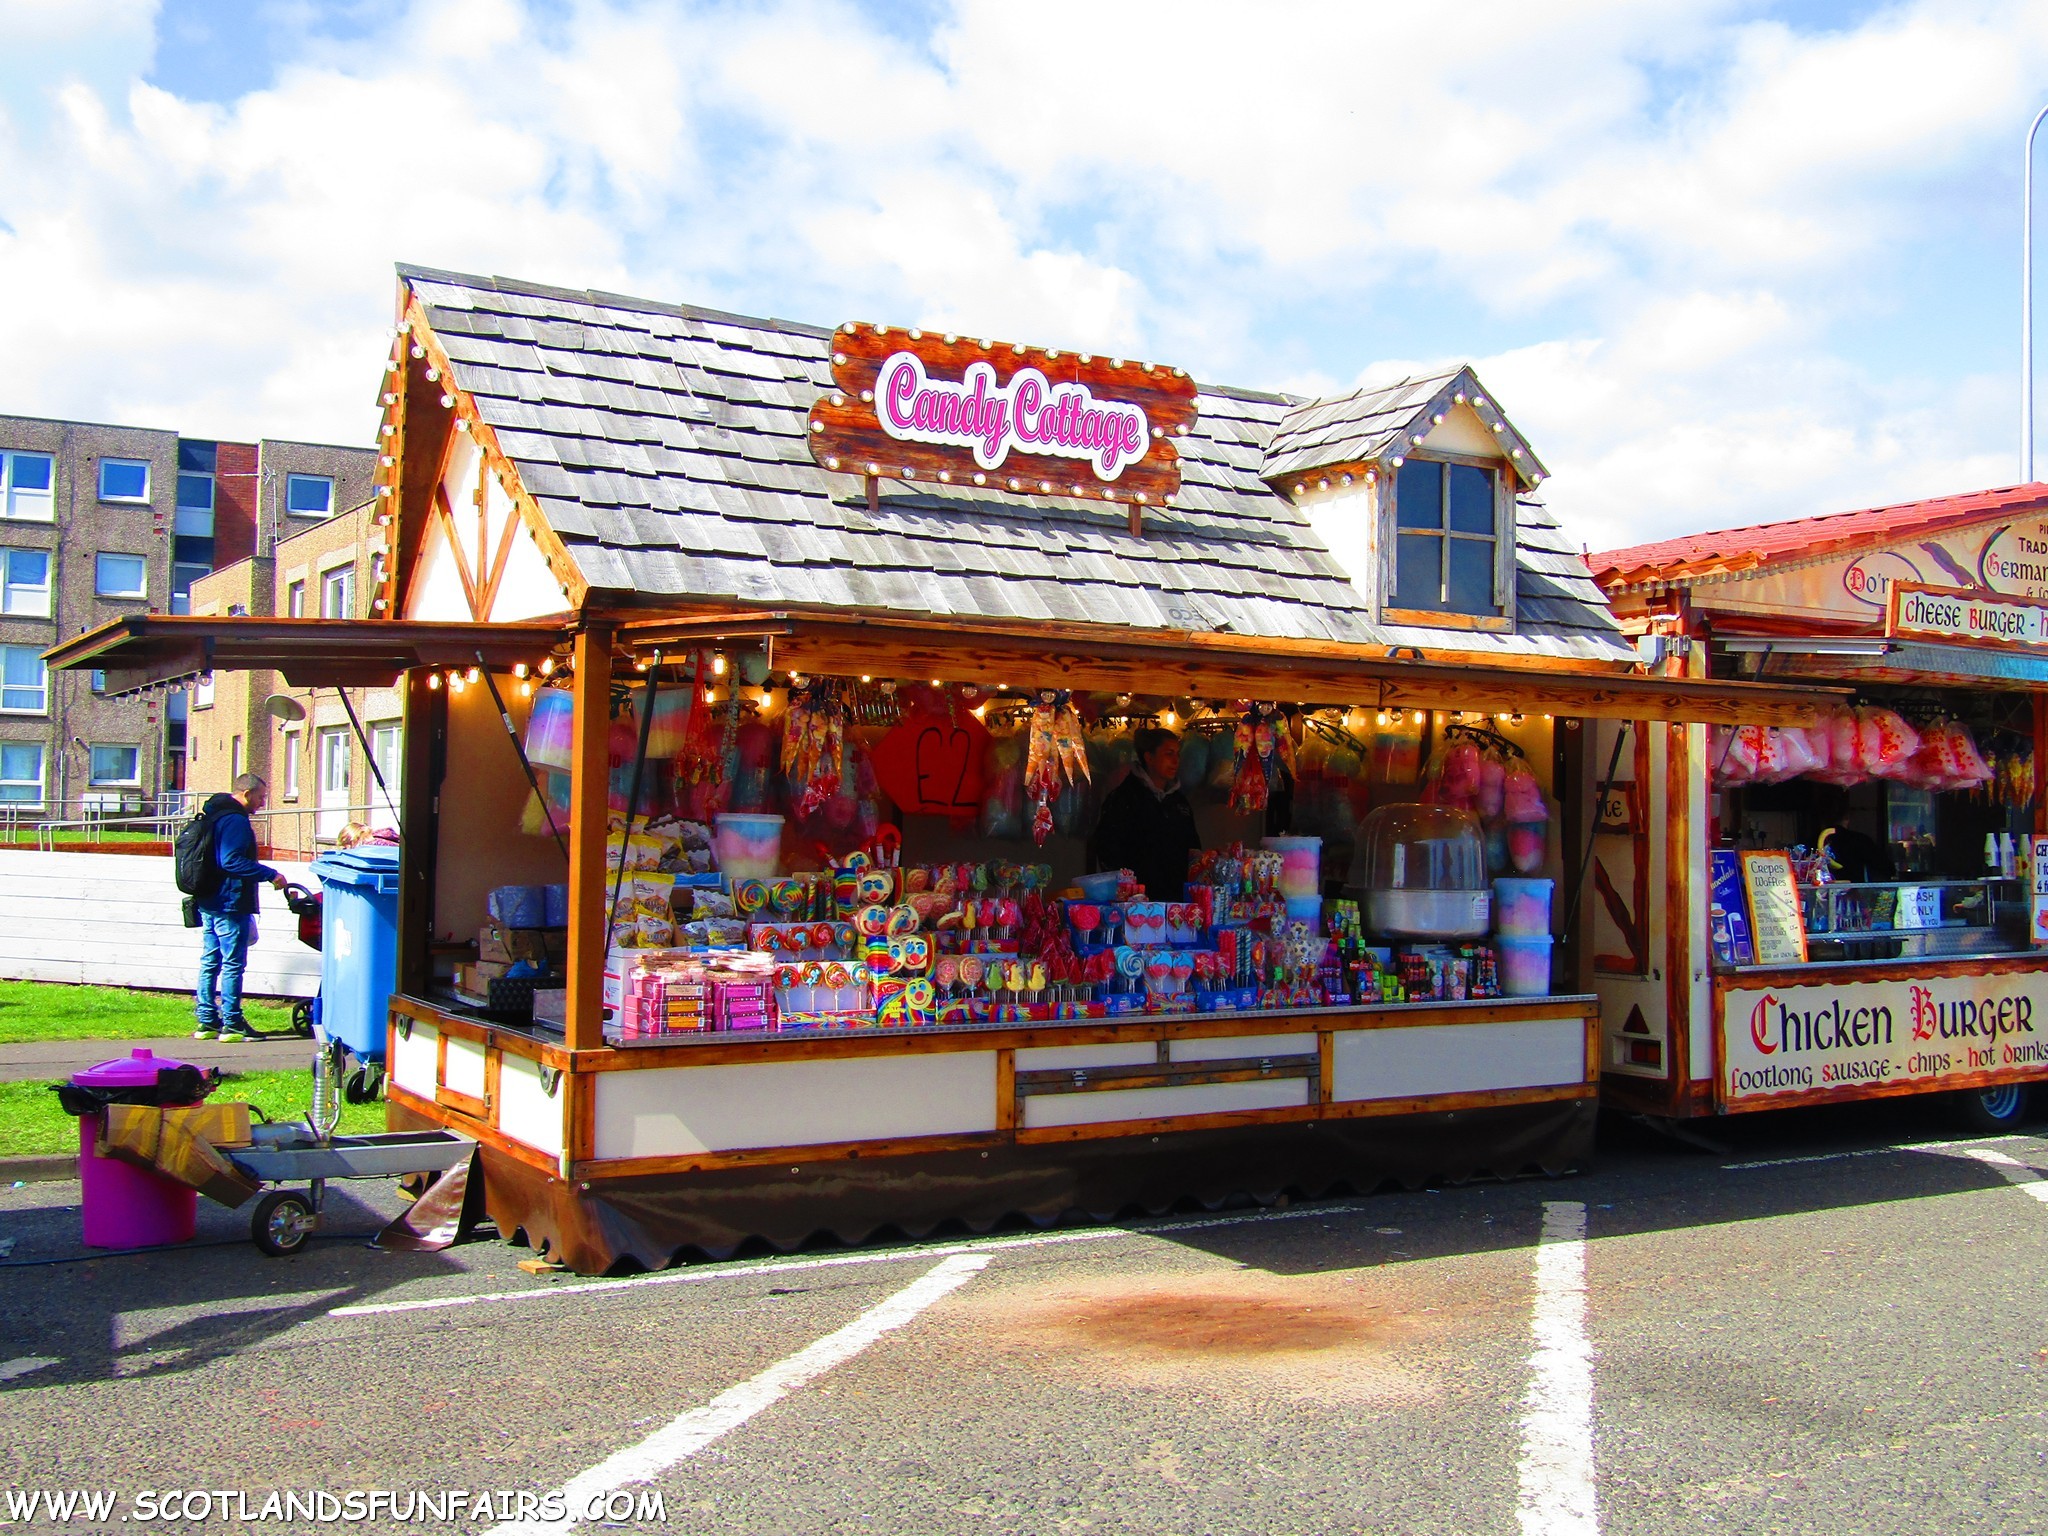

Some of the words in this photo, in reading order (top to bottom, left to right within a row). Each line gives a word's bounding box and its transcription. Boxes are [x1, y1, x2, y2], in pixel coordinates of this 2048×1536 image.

[887, 363, 1010, 459] Candy
[1012, 378, 1141, 471] Cottage
[1750, 860, 1785, 877] Crepes
[1754, 876, 1787, 888] Waffles
[1910, 892, 1934, 902] CASH
[1911, 906, 1934, 916] ONLY
[1731, 1064, 1813, 1095] footlong
[1908, 1051, 1951, 1077] chips
[1968, 1045, 1996, 1068] hot
